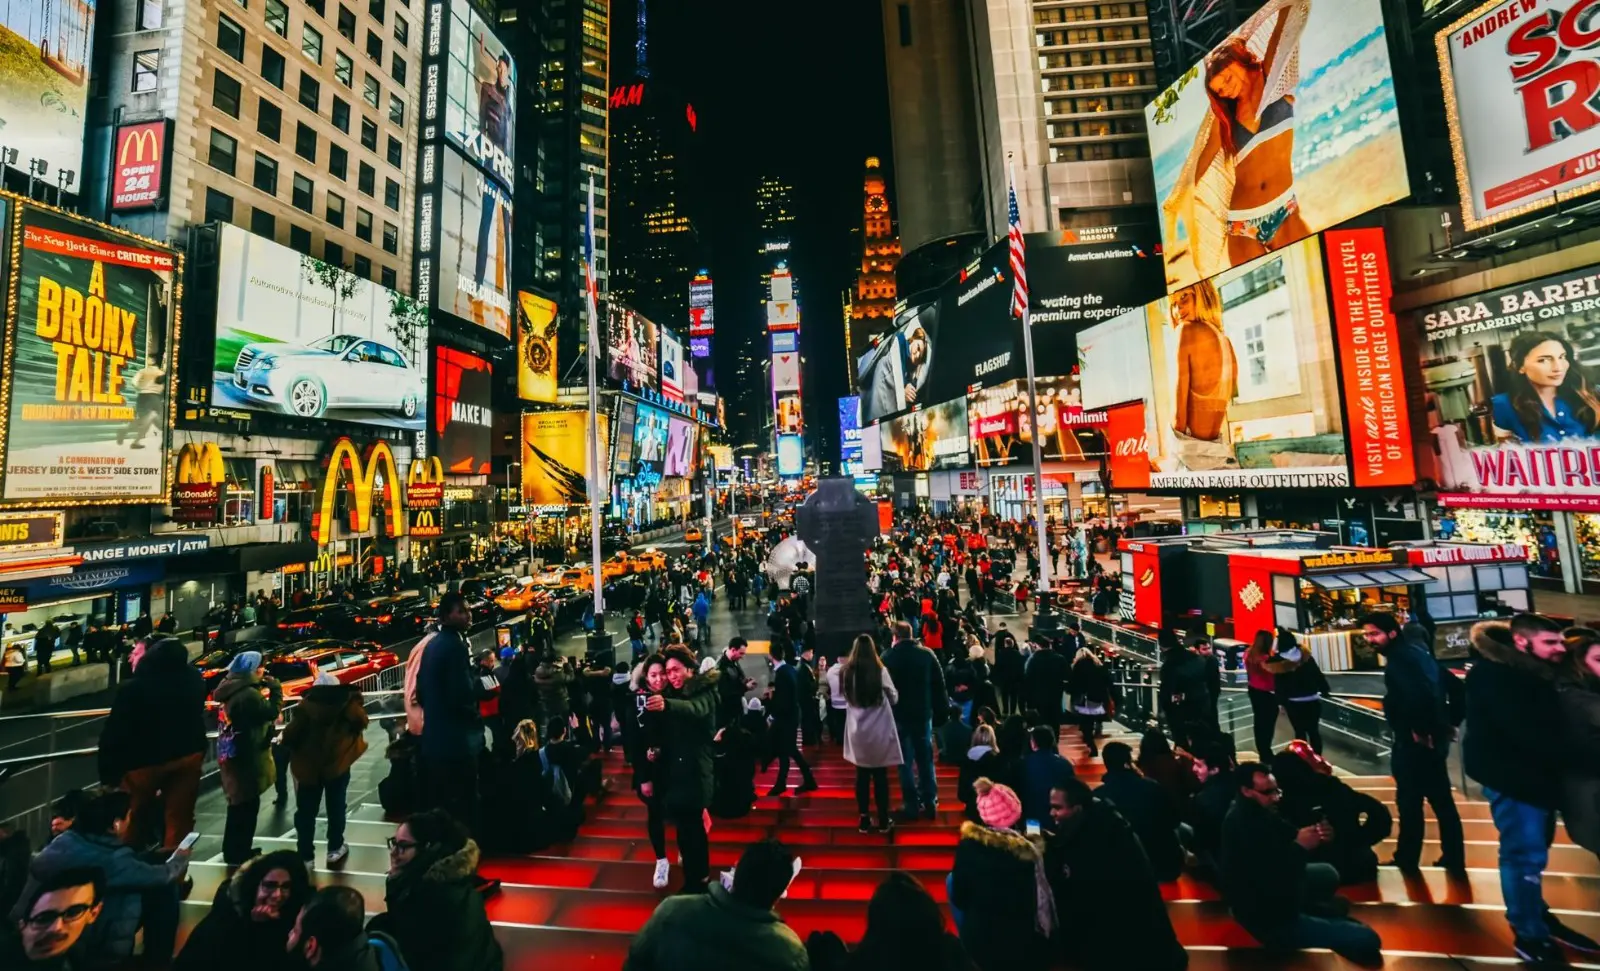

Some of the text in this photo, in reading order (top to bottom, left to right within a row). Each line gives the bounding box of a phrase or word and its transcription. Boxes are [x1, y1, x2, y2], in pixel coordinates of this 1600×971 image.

[426, 64, 438, 120] EXPRESS
[609, 83, 645, 108] H&M
[122, 165, 155, 177] OPEN
[125, 175, 150, 192] 24
[116, 191, 158, 203] HOURS
[1080, 226, 1118, 235] MARRIOTT
[1080, 233, 1115, 241] MARQUIS
[24, 230, 173, 267] The New York Times CRITICS' PICK
[88, 260, 104, 298] A
[1083, 293, 1103, 305] the
[1424, 275, 1600, 330] SARA BAREI
[36, 275, 137, 358] BRONX
[1029, 309, 1081, 325] premium
[1427, 328, 1457, 341] NOW
[1461, 312, 1534, 335] STARRING
[1539, 304, 1565, 319] ON
[975, 351, 1011, 377] FLAGSHIP
[1341, 239, 1384, 477] VISIT aerie INSIDE ON THE 3RD LEVEL
[1361, 252, 1402, 460] OF AMERICAN EAGLE OUTFITTERS
[52, 341, 126, 404] TALE
[452, 401, 480, 424] MAKE
[66, 455, 116, 465] COMBINATION
[117, 457, 126, 465] OF
[7, 466, 47, 475] JERSEY
[50, 466, 76, 475] BOYS
[78, 467, 85, 475] &
[88, 467, 112, 475] WEST
[114, 467, 132, 475] SIDE
[1151, 472, 1348, 489] AMERICAN EAGLE OUTFITTERS
[0, 523, 29, 541] NTS
[128, 543, 176, 557] MONEY
[183, 540, 207, 551] ATM
[51, 567, 129, 584] MONEY EXCHANGE
